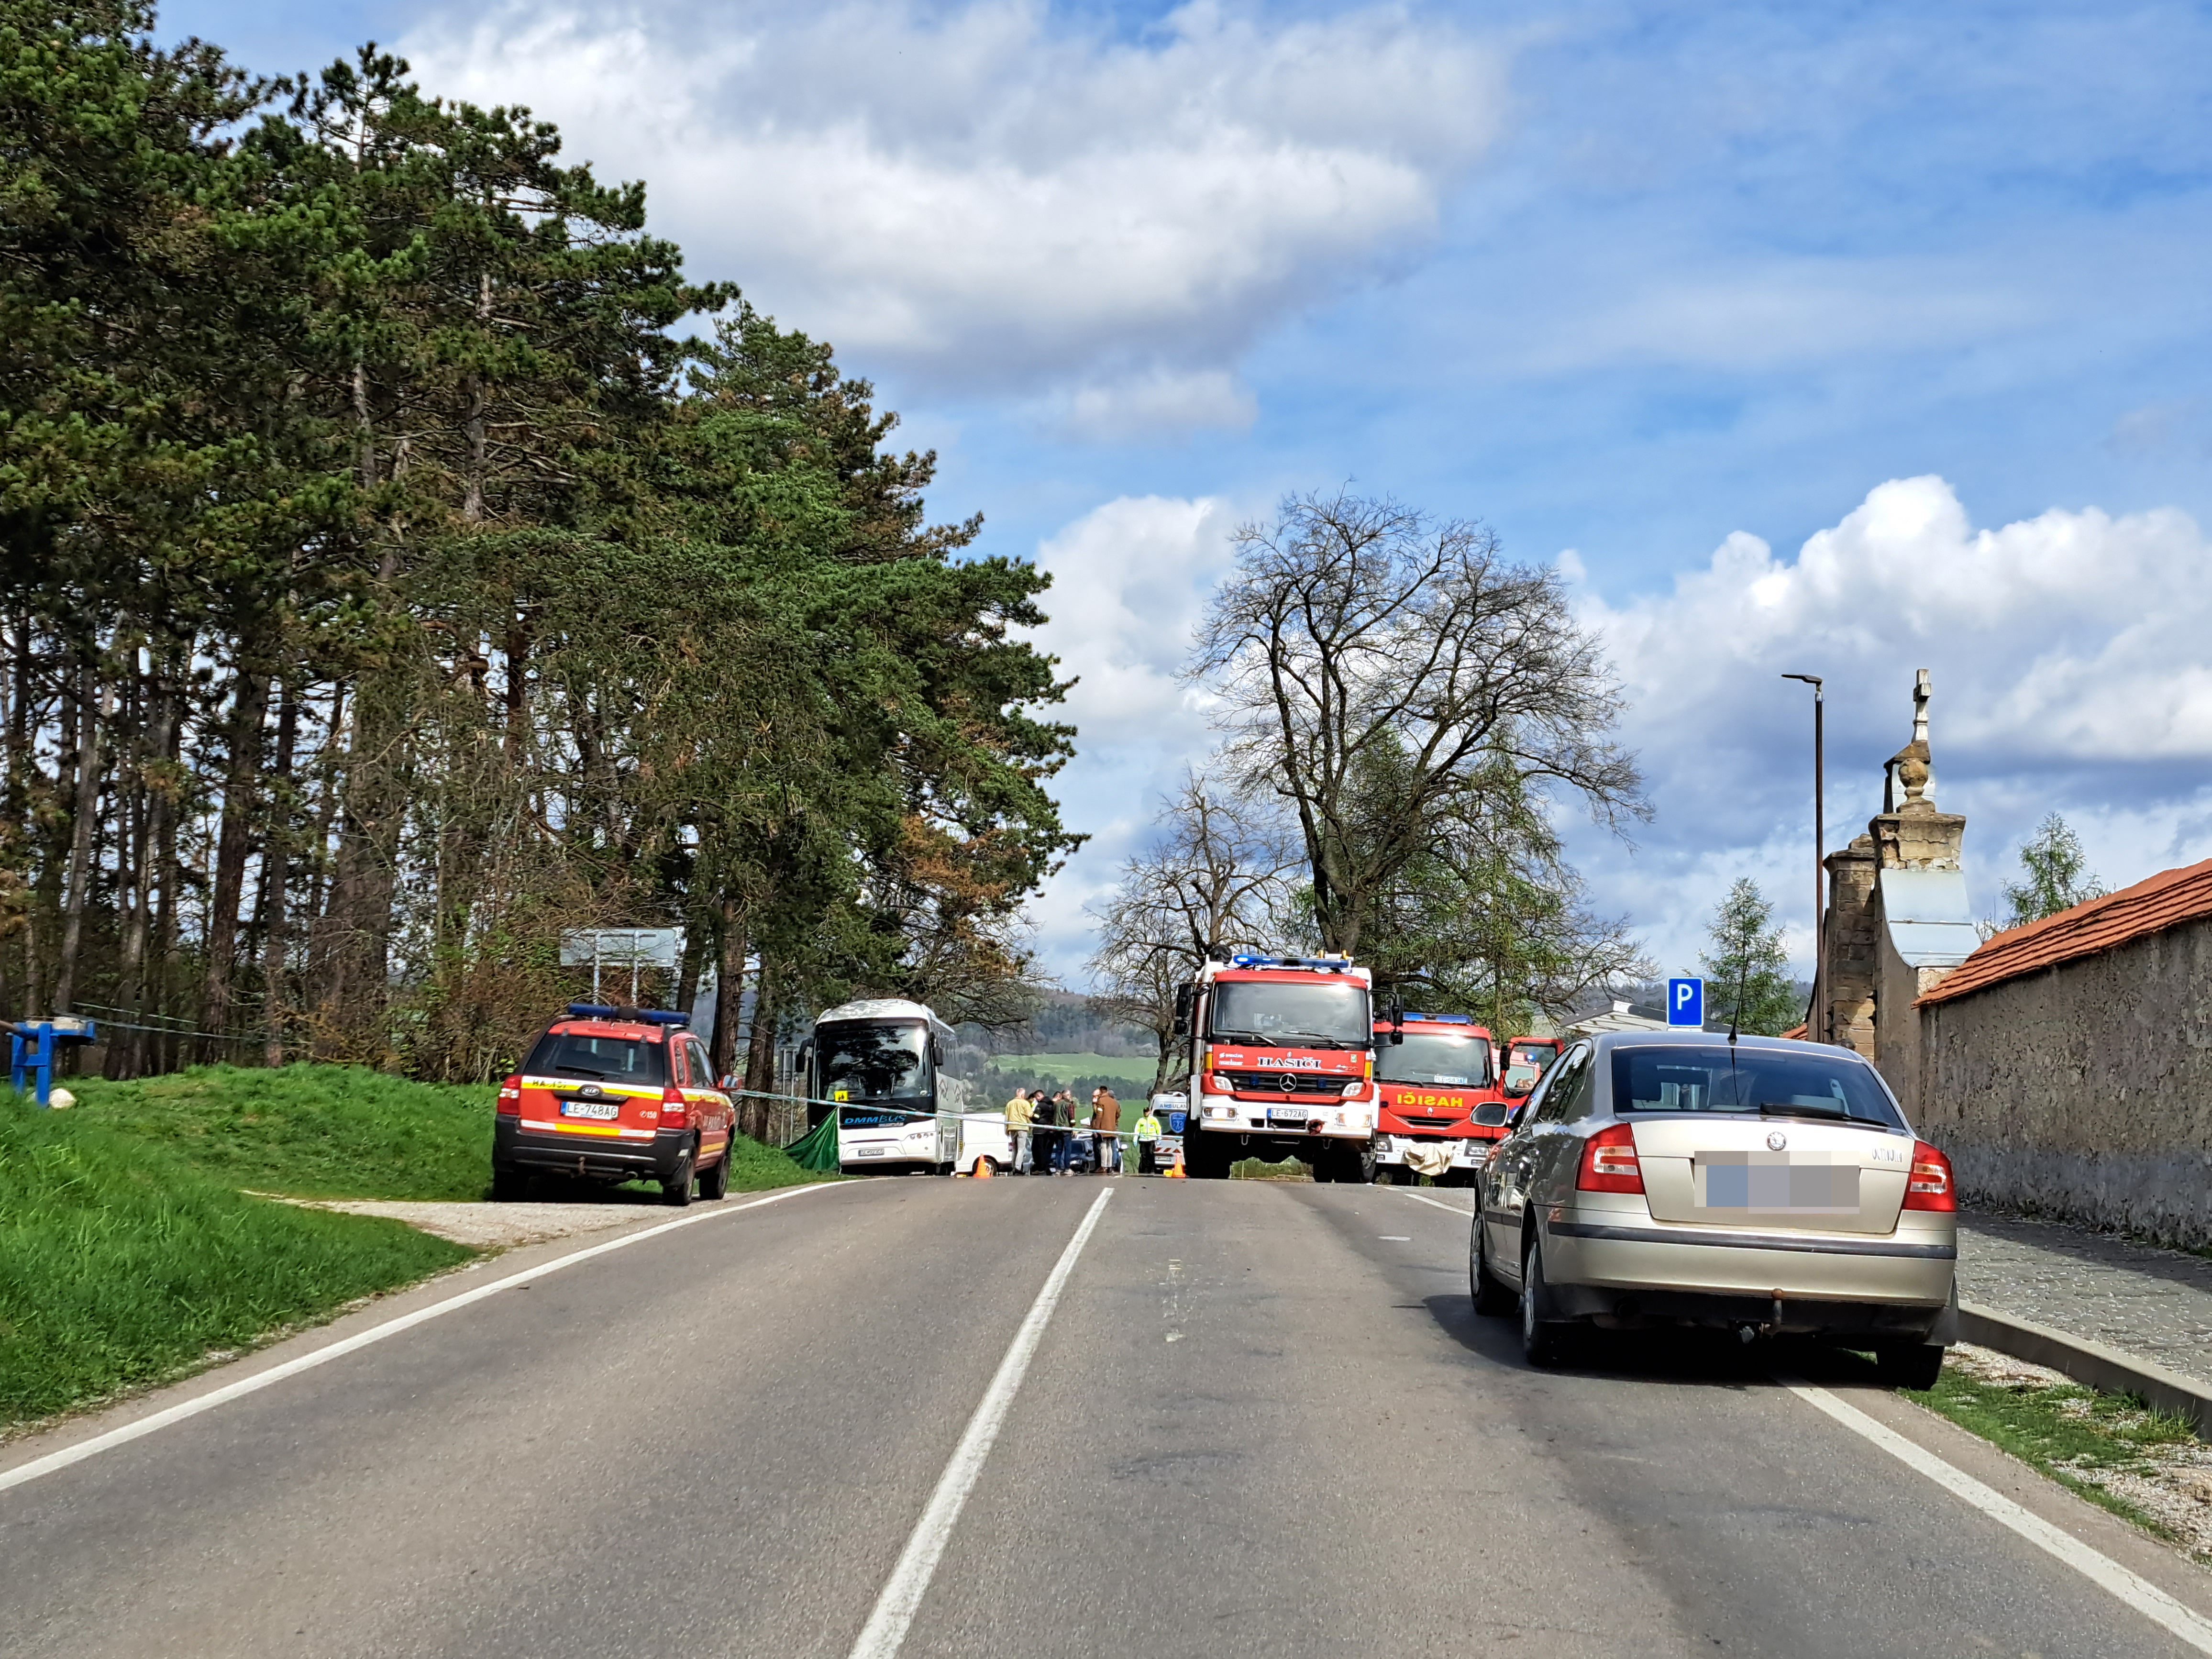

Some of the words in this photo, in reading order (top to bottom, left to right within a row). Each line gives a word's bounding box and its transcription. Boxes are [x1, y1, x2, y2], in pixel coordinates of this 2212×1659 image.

[1677, 983, 1693, 1010] P
[1257, 1056, 1322, 1070] HASIČI
[567, 1103, 617, 1117] LE-748AG
[1272, 1109, 1306, 1118] LE-672AG
